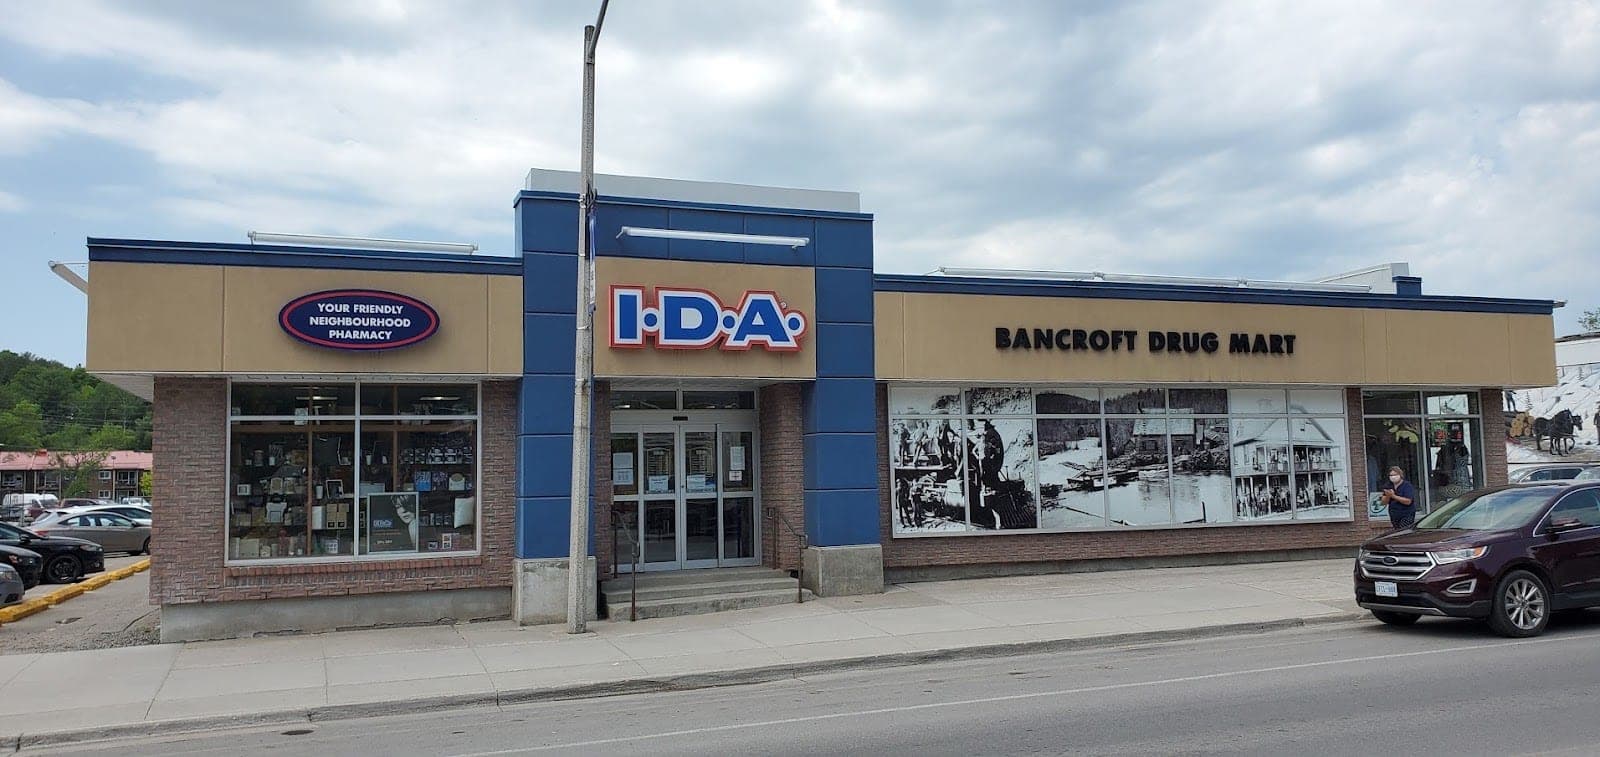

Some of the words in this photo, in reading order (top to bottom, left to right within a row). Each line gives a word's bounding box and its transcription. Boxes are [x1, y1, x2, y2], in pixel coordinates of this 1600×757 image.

[317, 303, 350, 313] YOUR
[353, 304, 404, 315] FRIENDLY
[309, 316, 411, 328] NEIGHBOURHOOD
[328, 330, 392, 340] PHARMACY
[995, 327, 1138, 351] BANCROFT
[1148, 331, 1219, 353] DRUG
[1229, 333, 1296, 354] MART
